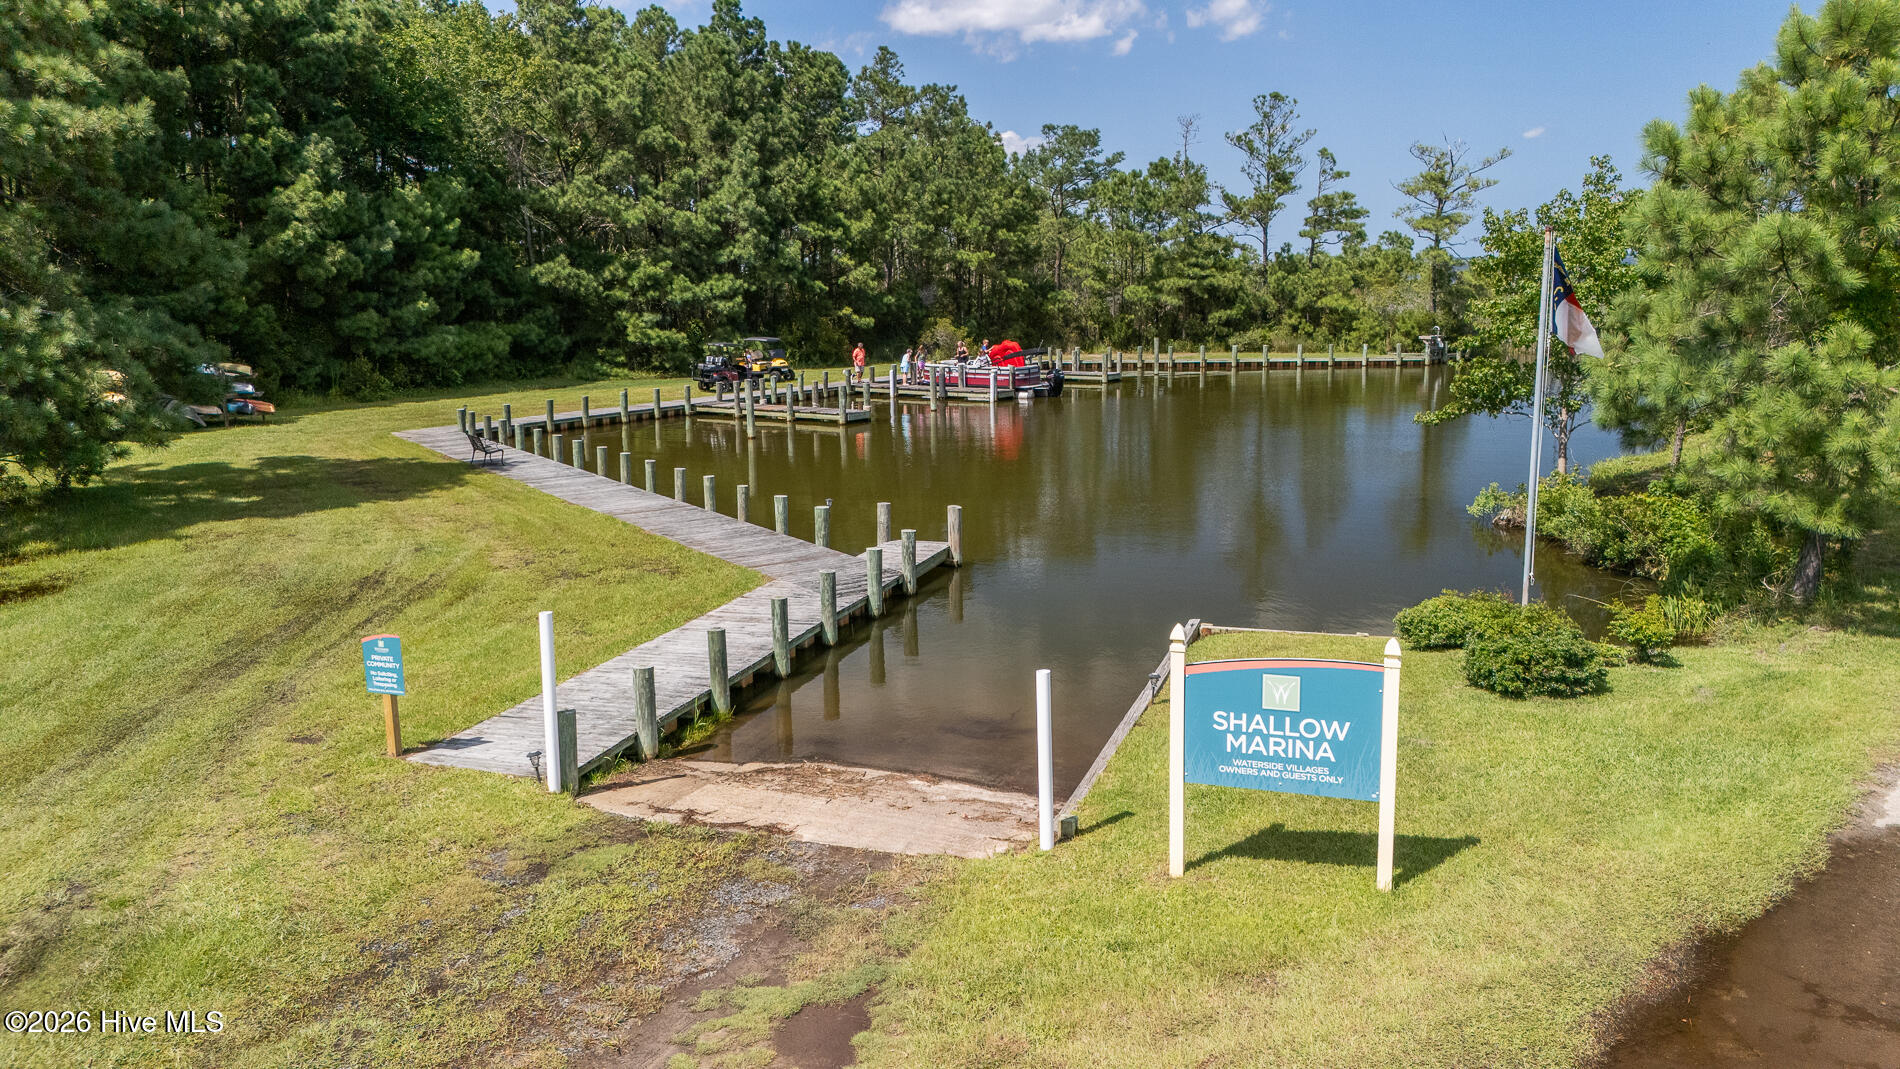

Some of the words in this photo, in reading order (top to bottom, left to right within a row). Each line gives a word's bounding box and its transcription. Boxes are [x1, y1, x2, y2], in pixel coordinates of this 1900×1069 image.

[366, 661, 400, 669] COMMUNITY
[1213, 710, 1351, 741] SHALLOW
[1226, 733, 1336, 762] MARINA
[1218, 765, 1259, 776] OWNERS
[1260, 769, 1281, 778] AND
[1282, 771, 1317, 782] GUESTS
[1319, 775, 1344, 785] ONLY
[1232, 758, 1284, 771] WATERSIDE
[1285, 764, 1330, 775] VILLAGES
